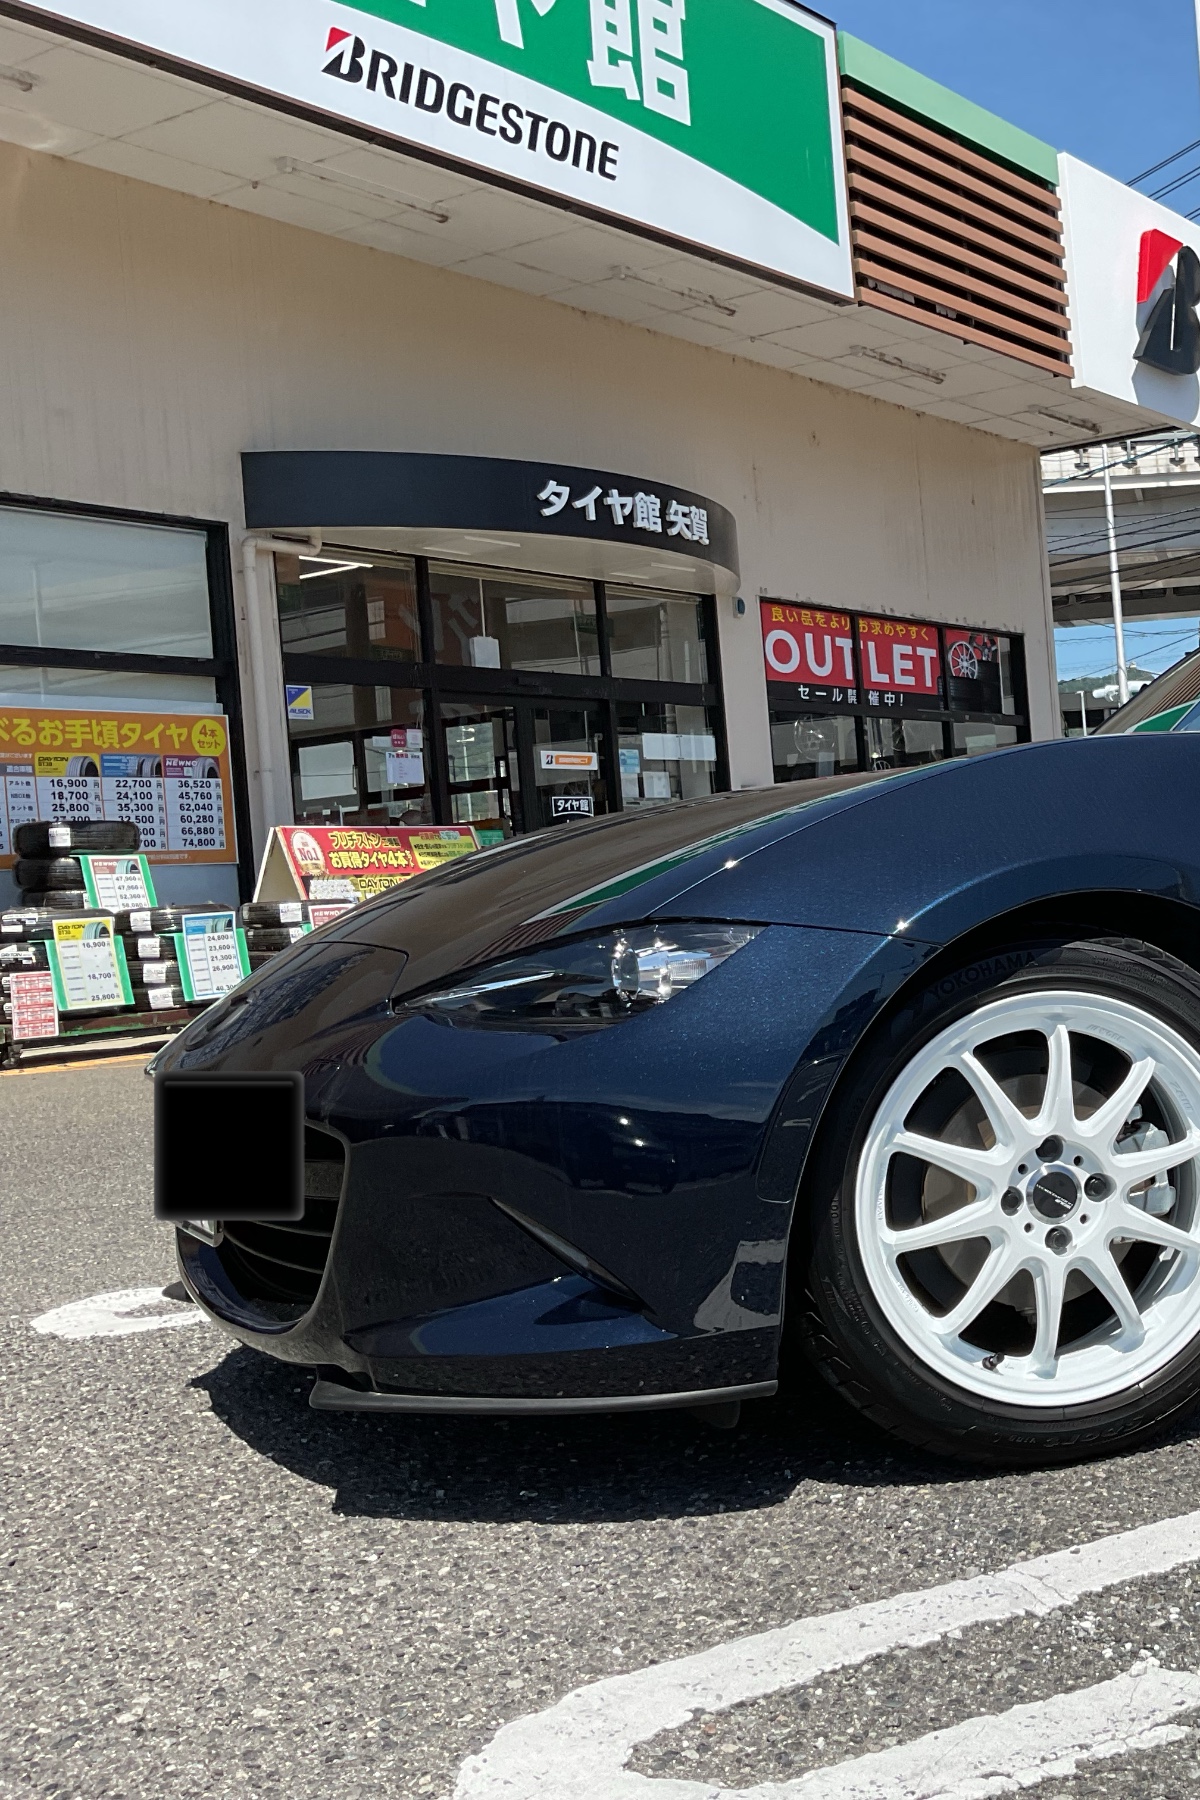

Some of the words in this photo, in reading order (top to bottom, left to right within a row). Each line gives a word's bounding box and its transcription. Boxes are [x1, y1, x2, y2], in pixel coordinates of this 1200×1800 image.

[321, 26, 619, 182] BRIDGESTONE
[537, 480, 662, 534] タイヤ館
[665, 500, 710, 546] 矢賀
[765, 629, 937, 688] OUTLET
[199, 724, 218, 738] 4本
[197, 739, 220, 749] セット
[50, 779, 88, 789] 16,900
[115, 780, 152, 789] 22,700
[178, 781, 211, 789] 36,520
[51, 791, 89, 801] 18,700
[116, 792, 153, 801] 24,100
[178, 792, 212, 802] 45,760
[52, 803, 90, 813] 25,800
[117, 803, 154, 813] 35,300
[179, 803, 213, 813] 62,040
[557, 799, 589, 812] タイヤ館
[180, 815, 214, 824] 60,280
[181, 827, 215, 836] 66,880
[182, 838, 216, 848] 74,800
[925, 951, 1039, 999] YOKOHAMA
